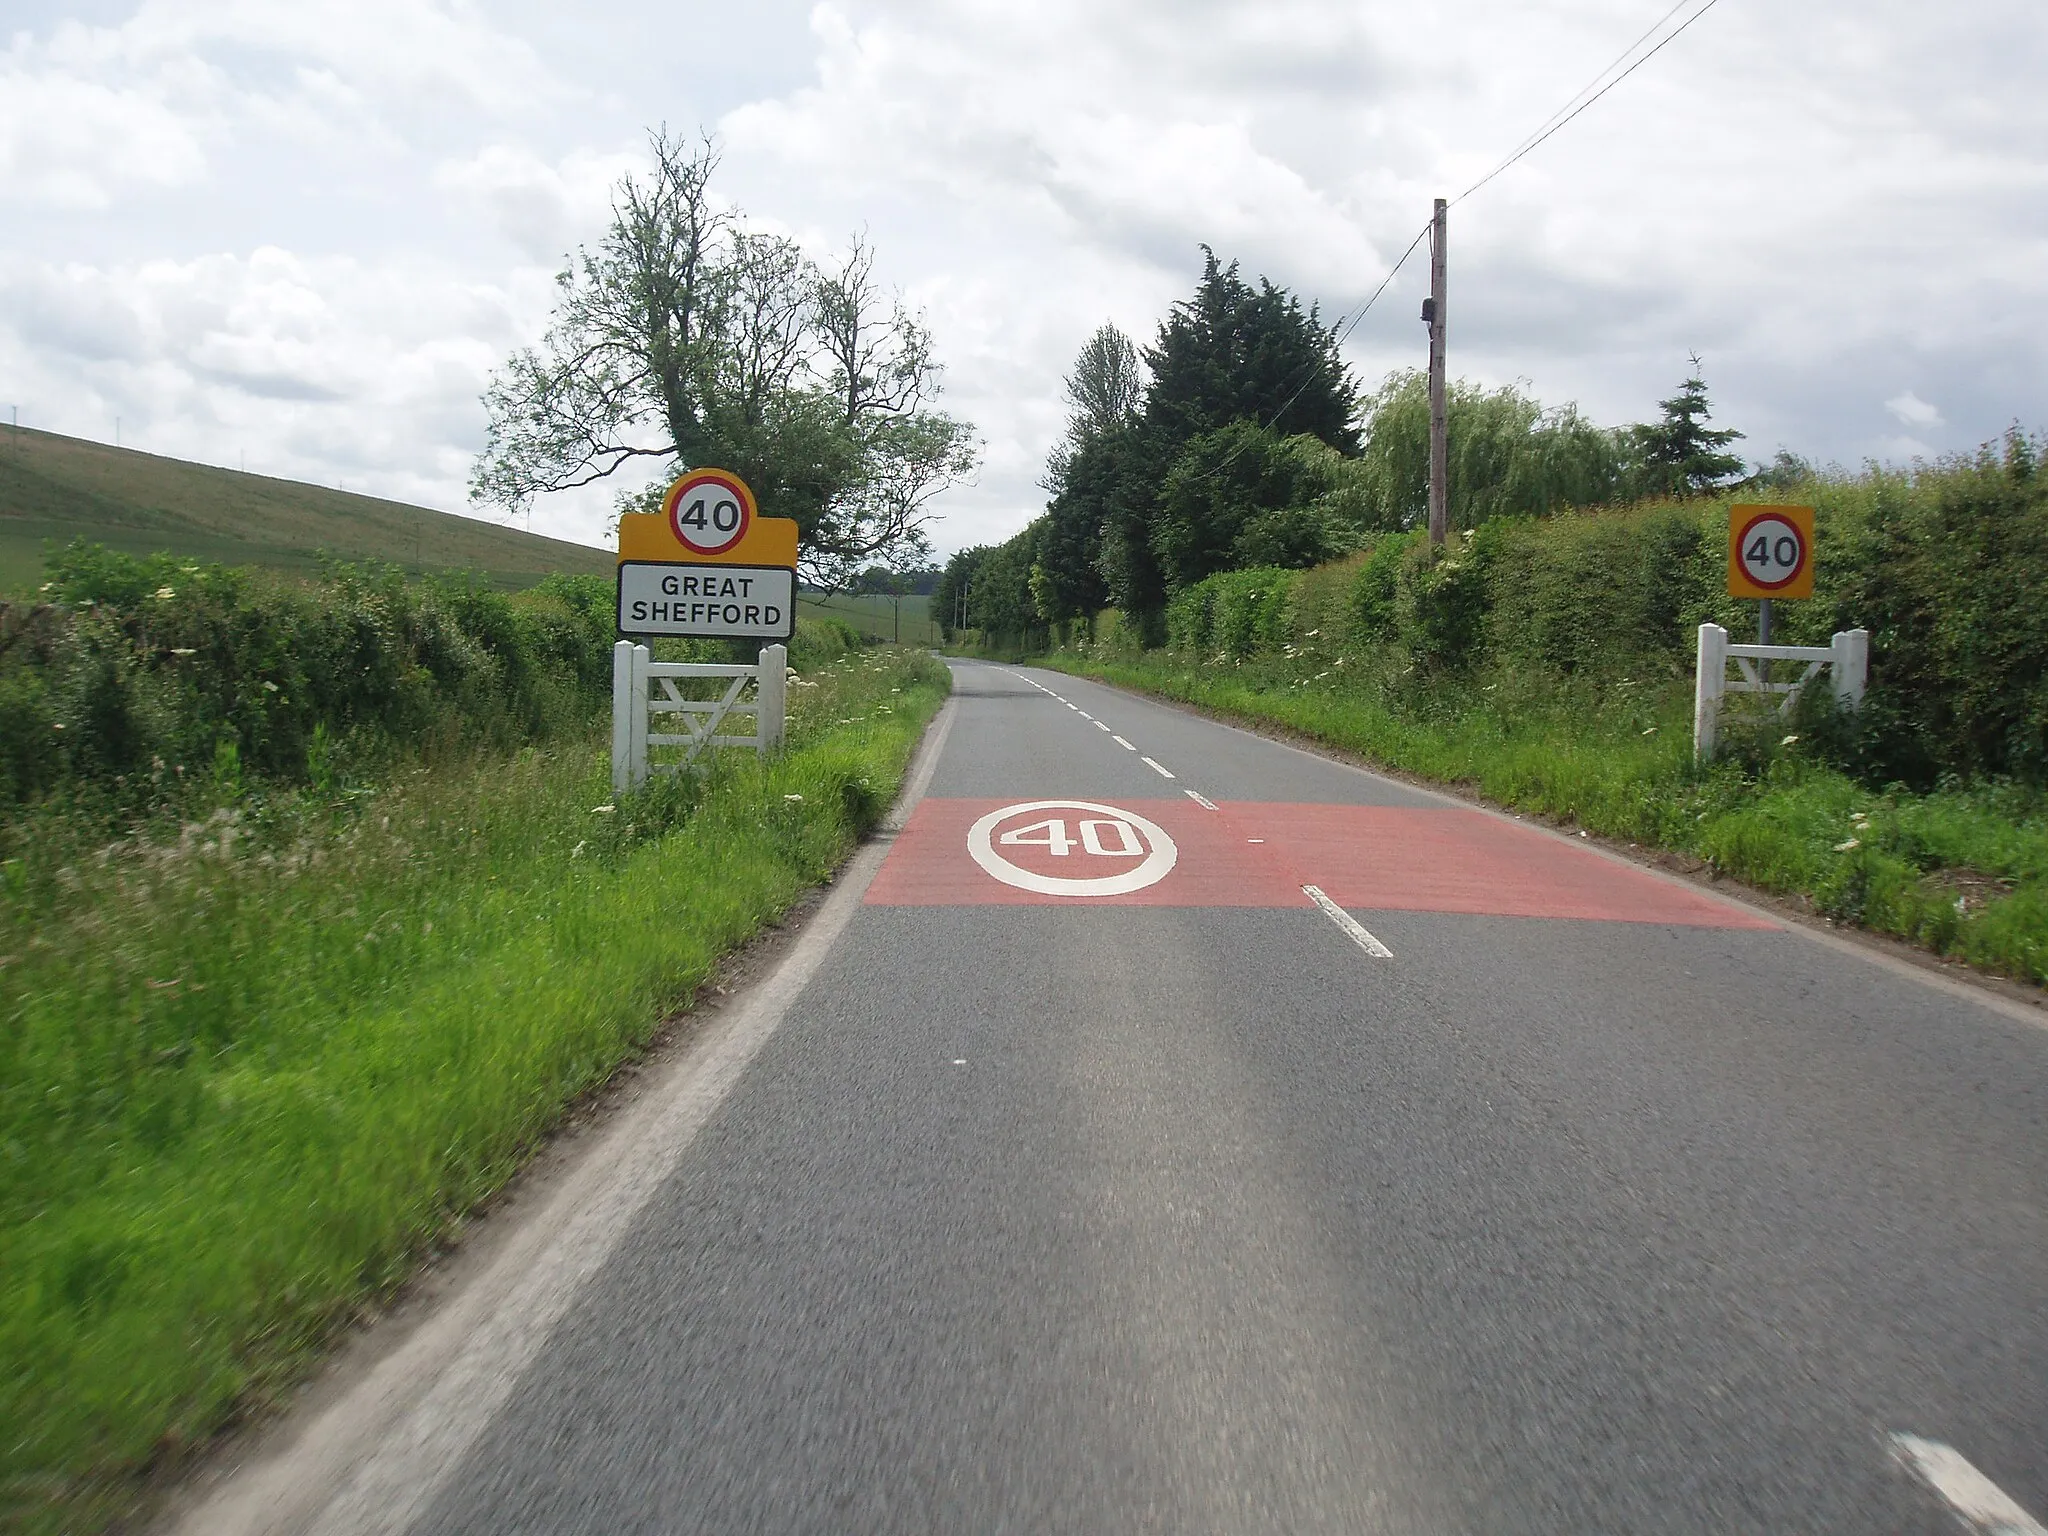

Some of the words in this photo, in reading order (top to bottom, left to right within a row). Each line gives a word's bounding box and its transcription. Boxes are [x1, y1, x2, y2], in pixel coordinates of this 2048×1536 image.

[681, 500, 739, 531] 40
[1746, 536, 1797, 567] 40
[661, 575, 753, 598] GREAT
[631, 601, 781, 625] SHEFFORD
[1000, 819, 1144, 856] 40
